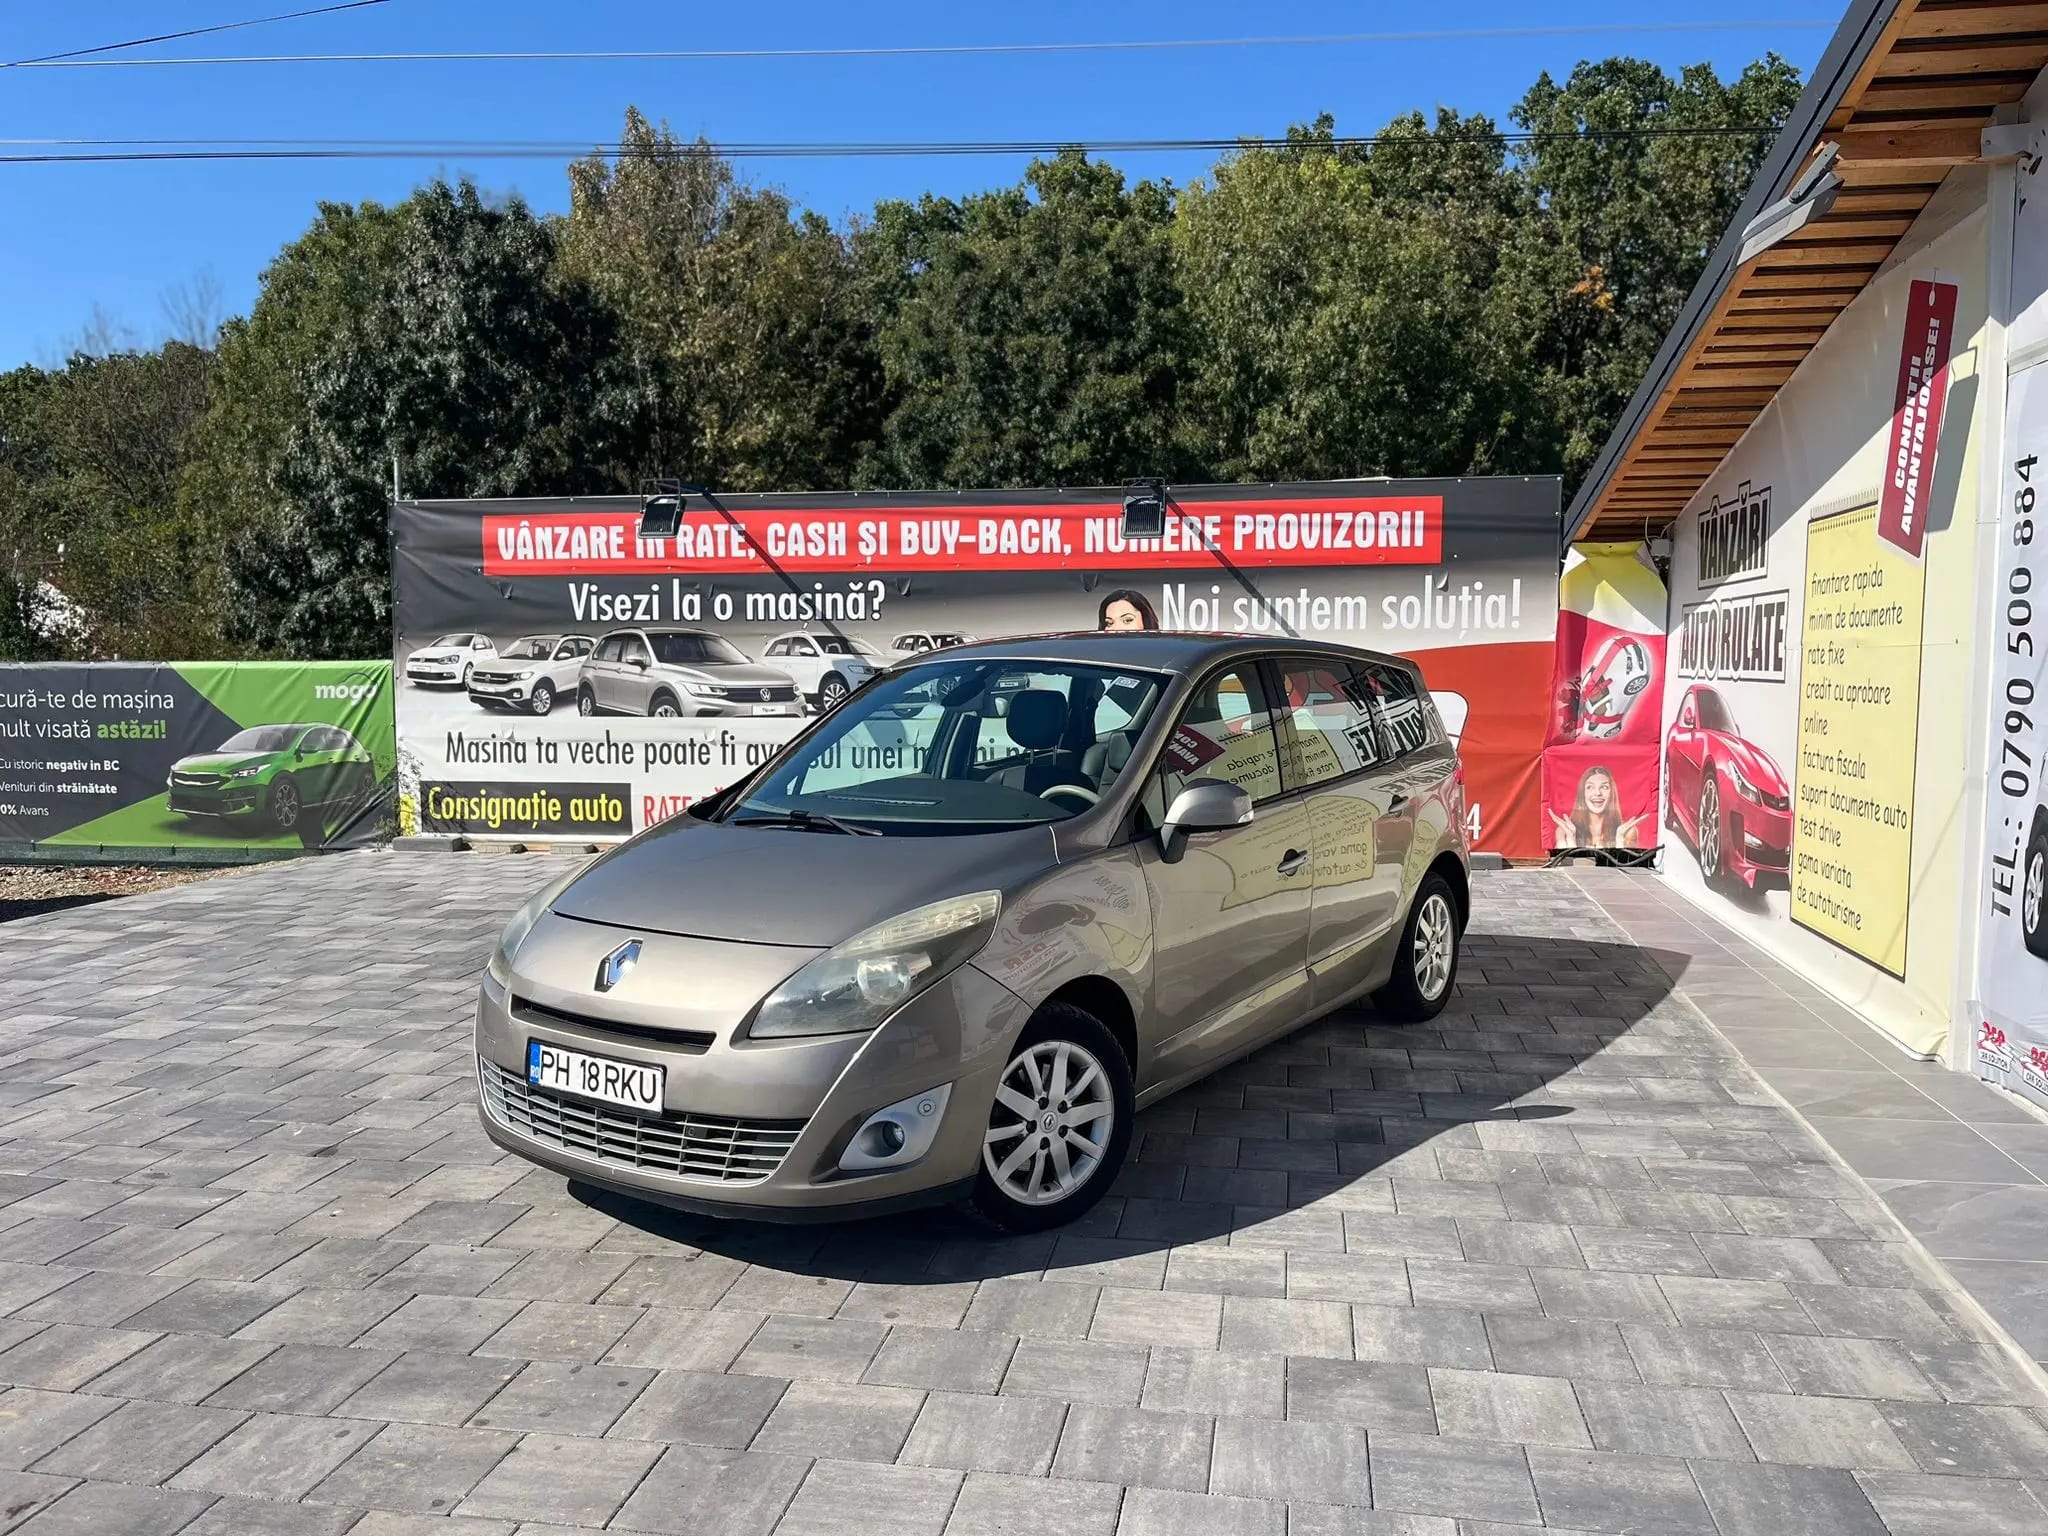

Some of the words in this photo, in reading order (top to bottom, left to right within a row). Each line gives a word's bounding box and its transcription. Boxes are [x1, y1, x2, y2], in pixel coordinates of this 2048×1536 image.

[1901, 318, 1940, 536] AVANTAJOASE!
[2013, 453, 2039, 547] 884
[497, 520, 625, 560] VÂNZARE
[677, 523, 756, 560] RATE,
[767, 522, 846, 557] CASH
[858, 521, 888, 564] ȘI
[900, 518, 1072, 557] BUY-BACK,
[1234, 510, 1425, 551] PROVIZORII
[1700, 492, 1768, 581] VÂNZĂRI
[568, 582, 660, 621] Visezi
[672, 578, 701, 621] la
[714, 593, 734, 621] o
[1812, 572, 1850, 599] finantare
[1852, 561, 1884, 598] rapida
[1162, 583, 1220, 631] Noi
[1233, 587, 1367, 631] suntem
[1382, 575, 1521, 638] soluția!
[1809, 603, 1833, 631] minim
[1835, 604, 1846, 630] de
[1849, 601, 1903, 629] documente
[2007, 567, 2033, 657] 500
[1807, 643, 1825, 666] rate
[1828, 641, 1845, 667] fixe
[72, 690, 96, 709] de
[103, 690, 174, 713] mașina
[1806, 678, 1832, 701] credit
[1834, 682, 1844, 702] cu
[1846, 678, 1891, 710] aprobare
[35, 719, 91, 738] visată
[97, 720, 166, 739] astăzi!
[1804, 710, 1828, 736] online
[2001, 678, 2034, 798] 0790
[13, 759, 44, 770] istoric
[46, 760, 88, 772] negativ
[103, 760, 120, 771] BC
[536, 736, 558, 764] ta
[567, 729, 634, 765] veche
[644, 735, 711, 773] poate
[721, 729, 736, 765] fi
[851, 737, 903, 769] unei
[1803, 744, 1834, 773] factura
[1836, 749, 1866, 779] fiscala
[39, 782, 54, 793] din
[57, 782, 118, 794] străinătate
[428, 786, 561, 829] Consignație
[569, 794, 623, 823] auto
[1801, 783, 1828, 810] suport
[1830, 784, 1881, 822] documente
[1884, 803, 1908, 830] auto
[20, 805, 49, 816] Avans
[1800, 813, 1817, 839] test
[1819, 816, 1842, 847] drive
[1798, 852, 1819, 875] gama
[1821, 859, 1852, 889] variata
[1797, 879, 1807, 904] de
[1809, 890, 1862, 931] autoturisme
[540, 1050, 570, 1086] PH
[580, 1059, 600, 1092] 18
[604, 1064, 657, 1104] RKU
